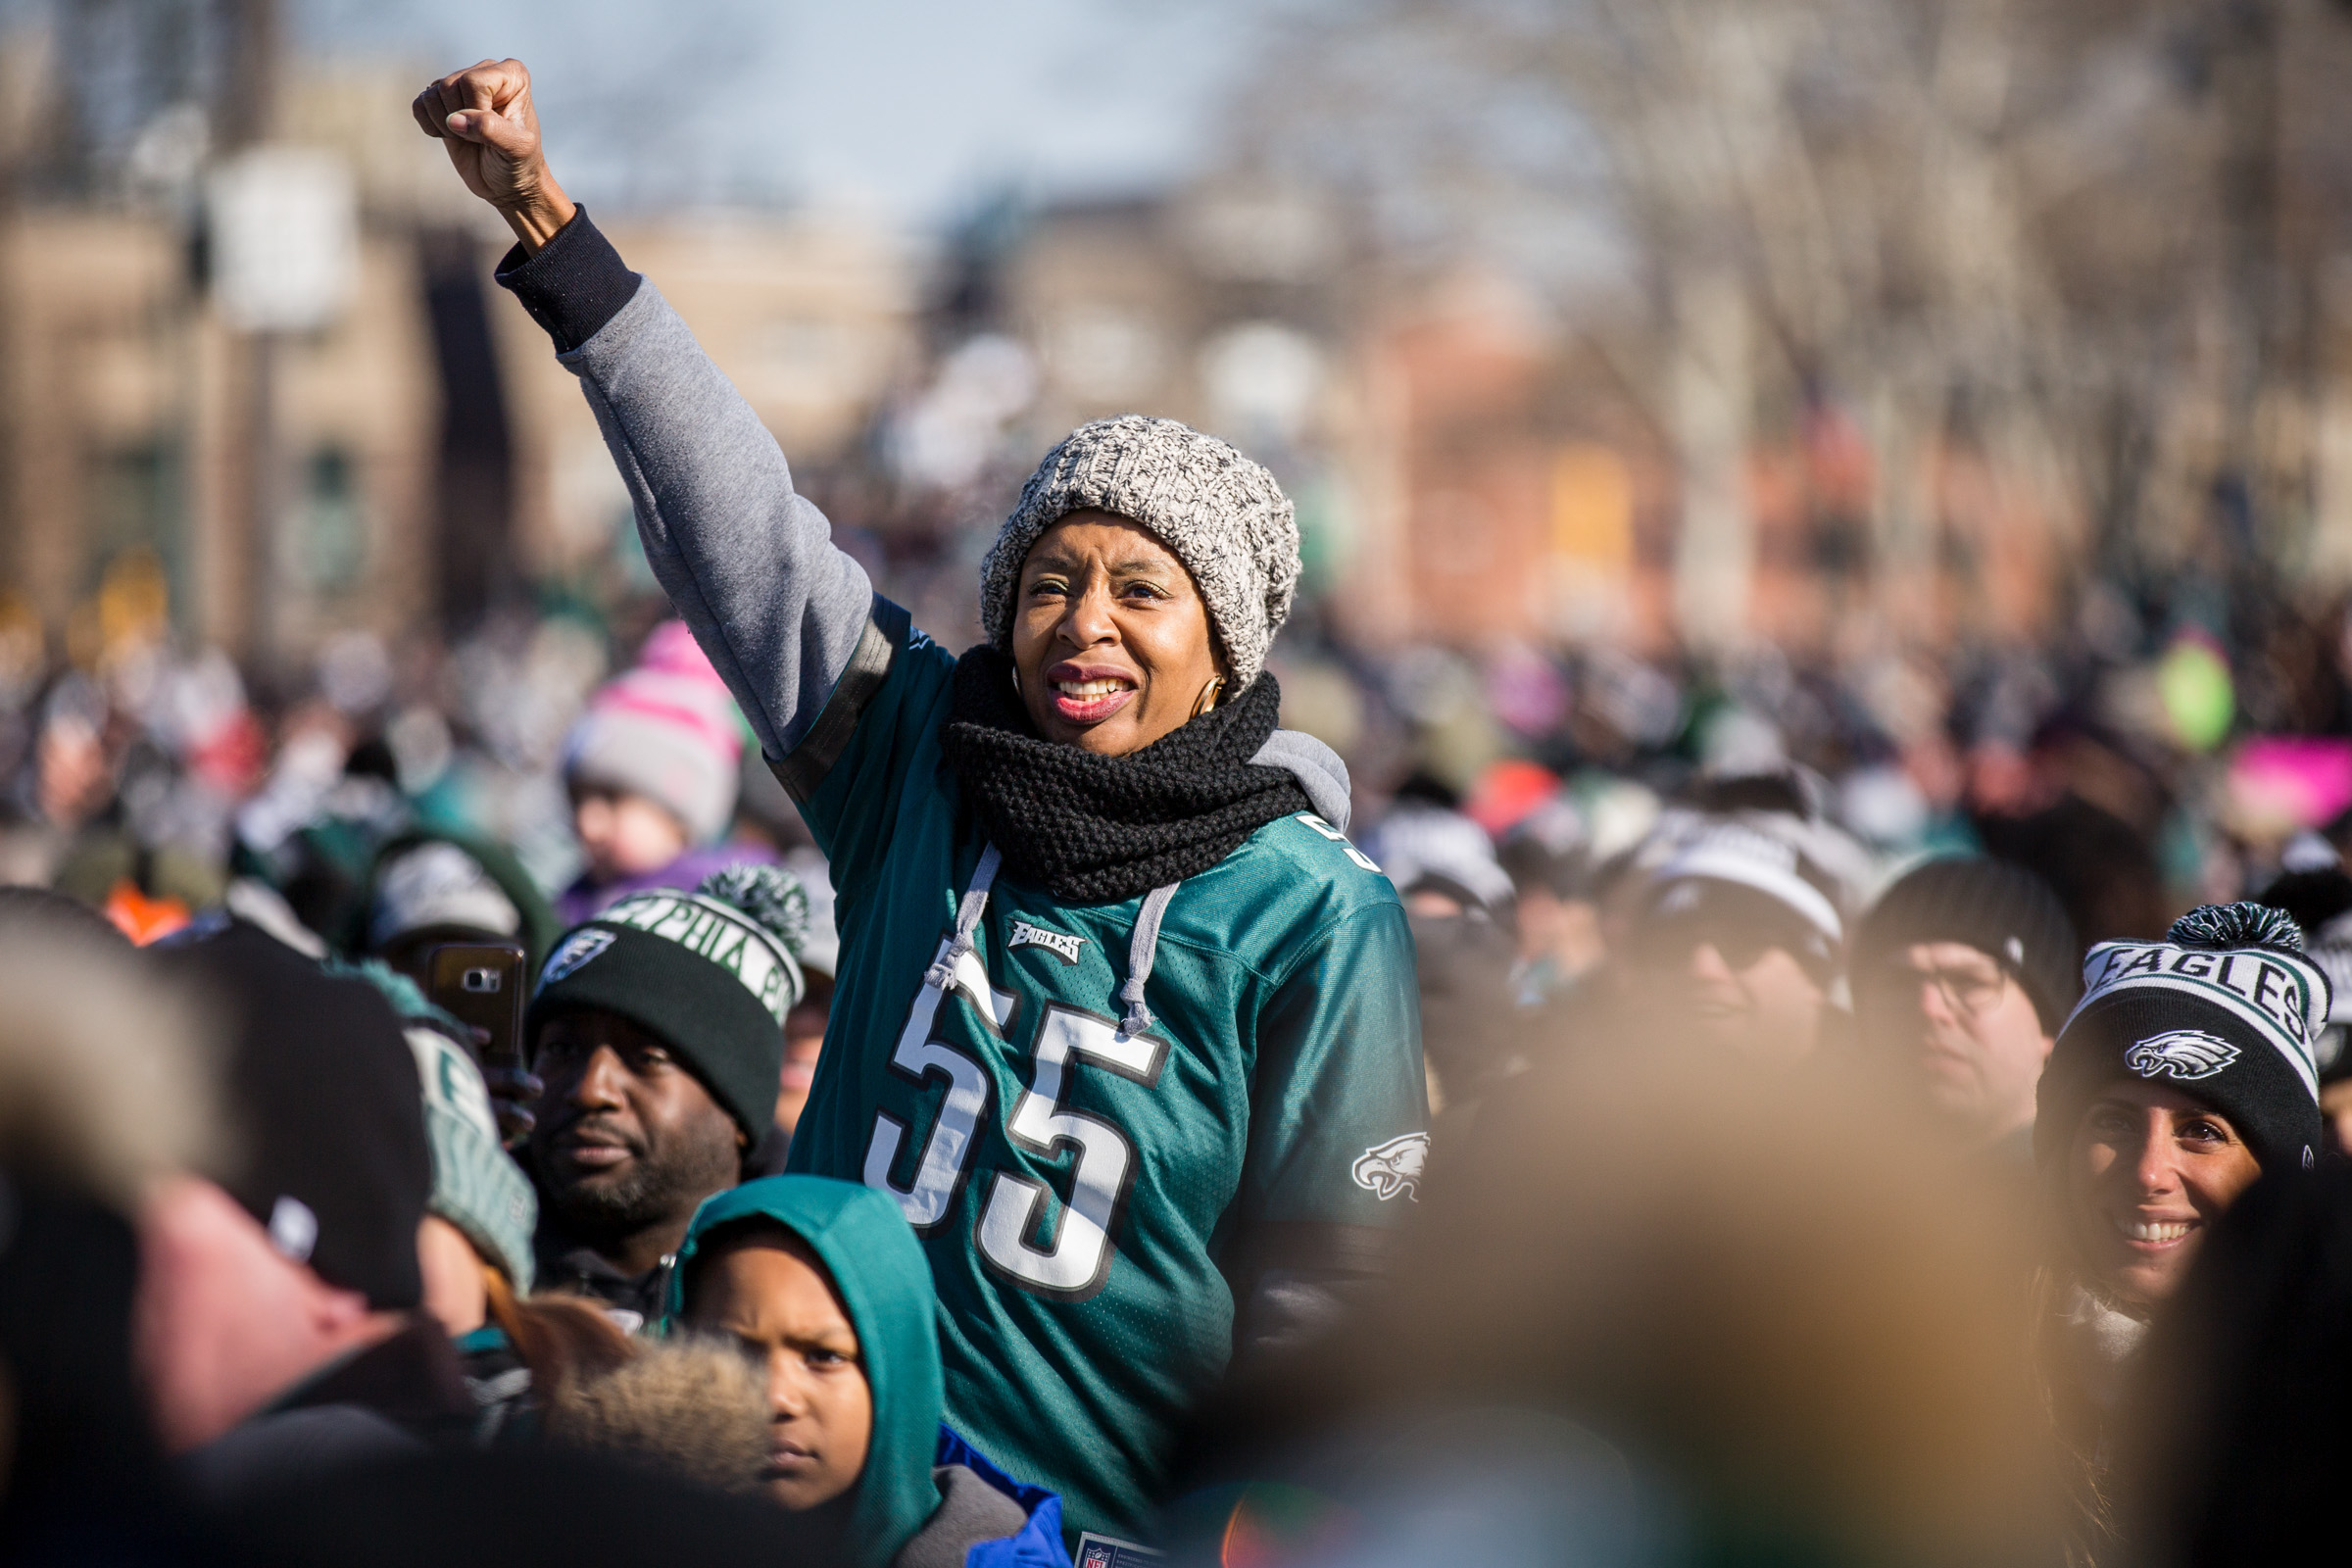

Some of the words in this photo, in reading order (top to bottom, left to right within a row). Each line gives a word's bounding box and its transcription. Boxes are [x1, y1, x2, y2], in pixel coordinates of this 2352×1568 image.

[1007, 920, 1086, 964] EAGLES
[2088, 948, 2306, 1046] EAGLES
[862, 931, 1164, 1296] 55
